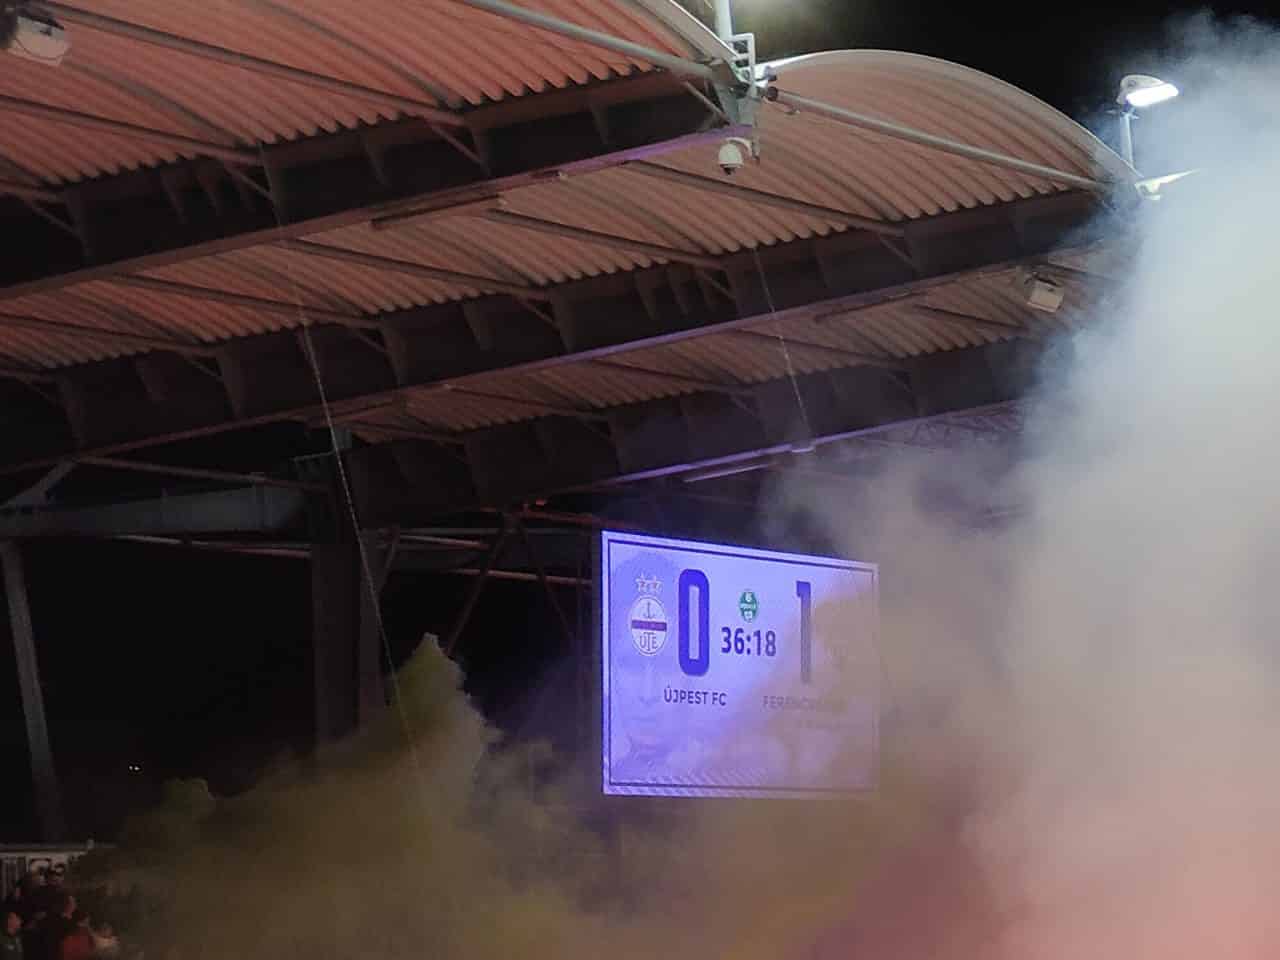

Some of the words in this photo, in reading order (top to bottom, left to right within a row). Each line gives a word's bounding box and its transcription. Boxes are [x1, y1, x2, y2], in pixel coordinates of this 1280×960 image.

[678, 569, 710, 676] 0
[721, 626, 777, 656] 36:18
[664, 685, 708, 704] ÚJPEST
[712, 692, 727, 706] FC
